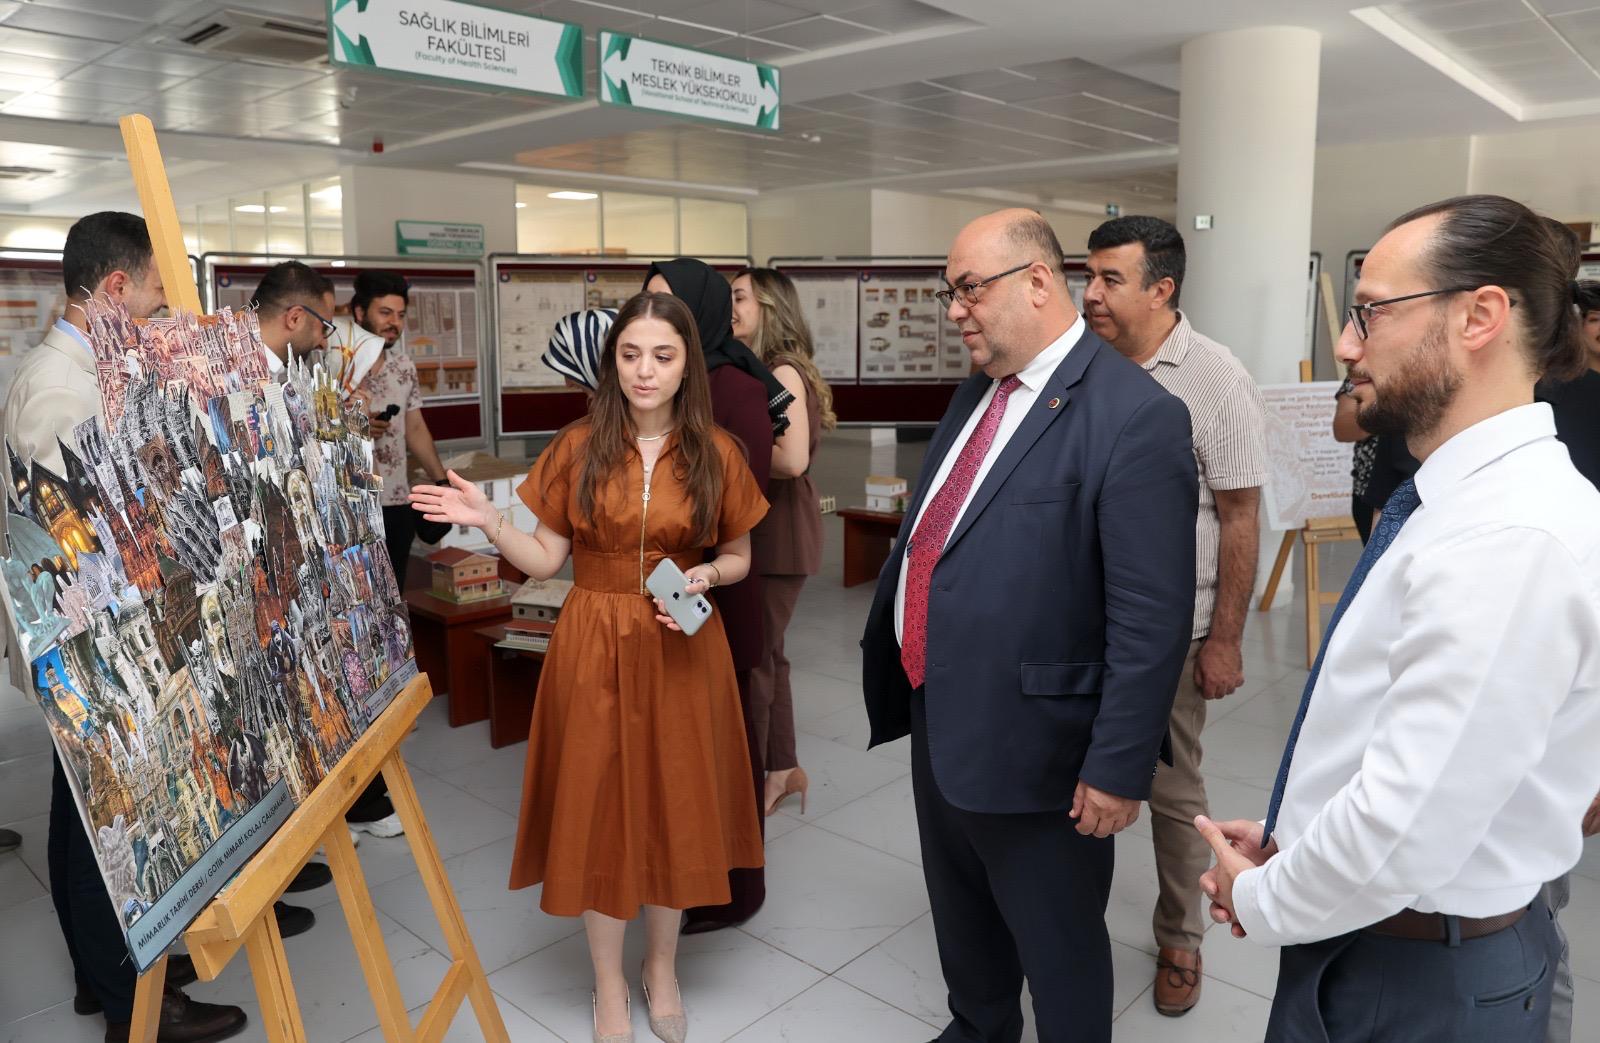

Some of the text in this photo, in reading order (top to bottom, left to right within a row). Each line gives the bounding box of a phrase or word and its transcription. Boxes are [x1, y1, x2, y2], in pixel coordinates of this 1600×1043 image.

[399, 10, 530, 48] SAĞLIK BİLİMLERİ
[415, 51, 446, 64] (Faculty
[457, 58, 482, 69] Health
[483, 62, 518, 75] Sciences)
[427, 35, 506, 62] FAKÜLTESİ
[650, 58, 741, 87] TEKNİK BİLİMLER
[631, 72, 757, 106] MESLEK YÜKSEKOKULU
[137, 913, 171, 950] MİMARLIK
[170, 896, 190, 917] TARİHİ
[188, 878, 205, 898] DERSİ
[223, 836, 245, 860] MİMARİ
[243, 821, 262, 841] KOLAJ
